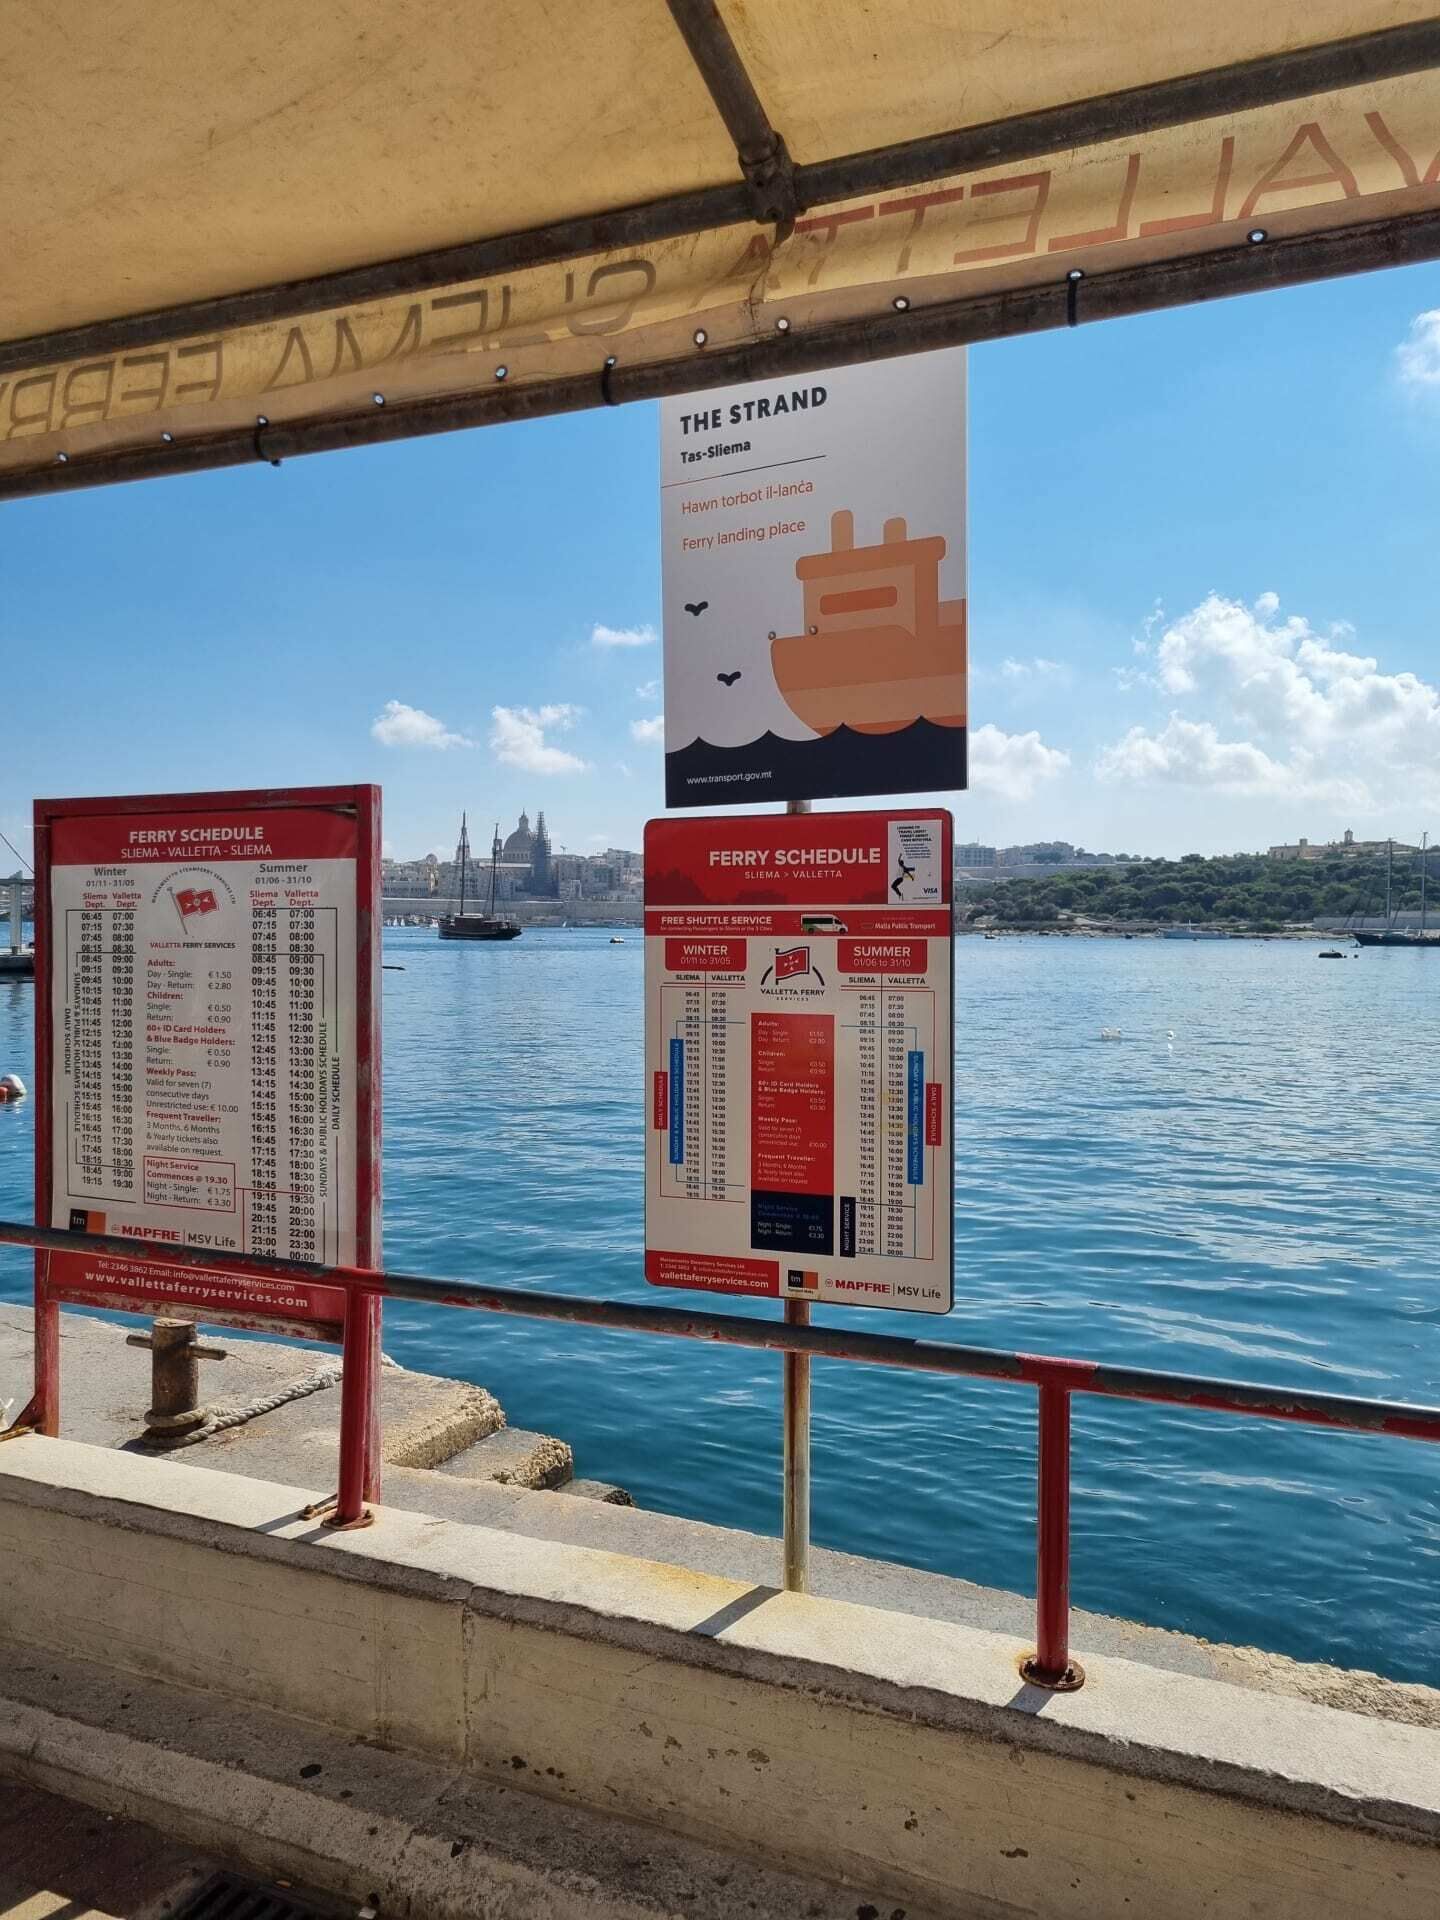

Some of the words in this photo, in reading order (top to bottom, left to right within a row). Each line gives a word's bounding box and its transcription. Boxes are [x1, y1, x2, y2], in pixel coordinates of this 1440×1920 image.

[680, 408, 722, 435] THE
[729, 386, 828, 425] STRAND
[680, 440, 752, 464] Tas-Sliema
[682, 498, 719, 515] Hawn
[722, 488, 763, 507] torbot
[683, 535, 714, 552] Ferry
[717, 525, 766, 545] landing
[769, 519, 806, 538] place
[687, 770, 772, 785] www.transport.gov.mt
[129, 829, 177, 844] FERRY
[180, 826, 264, 842] SCHEDULE
[121, 847, 160, 859] SLIEMA
[168, 845, 222, 857] VALLETTA
[231, 844, 273, 856] SLIEMA
[709, 850, 769, 867] FERRY
[775, 847, 881, 865] SCHEDULE
[94, 867, 127, 877] Winter
[259, 863, 309, 873] Summer
[744, 871, 780, 880] SLIEMA
[792, 869, 843, 879] VALLETTA
[86, 880, 107, 888] 01/11
[113, 879, 135, 887] 31/05
[255, 877, 280, 885] 01/06
[287, 876, 312, 884] 31/10
[82, 892, 108, 900] Sliema
[112, 891, 142, 900] Valletta
[249, 890, 279, 898] Sliema
[284, 889, 319, 898] Valletta
[85, 901, 106, 909] Dept.
[116, 900, 138, 908] Dept.
[252, 899, 276, 908] Dept.
[289, 898, 314, 907] Dept.
[252, 910, 276, 918] 06:45
[289, 910, 314, 918] 07:00
[252, 922, 276, 930] 07:15
[289, 921, 314, 930] 07:30
[661, 916, 685, 925] FREE
[686, 916, 729, 925] SHUTTLE
[731, 916, 772, 925] SERVICE
[252, 933, 276, 941] 07:45
[289, 933, 314, 941] 08:00
[683, 945, 728, 956] WINTER
[853, 946, 911, 957] SUMMER
[878, 959, 889, 967] to
[892, 958, 911, 968] 31/10
[147, 970, 162, 979] Day
[252, 967, 276, 975] 09:15
[289, 967, 314, 976] 09:30
[888, 977, 925, 985] VALLETTA
[147, 992, 184, 1000] Children:
[252, 1000, 276, 1009] 10:45
[289, 1001, 314, 1010] 11:00
[173, 1025, 192, 1033] Card
[194, 1026, 226, 1034] Holders
[173, 1036, 199, 1045] Badge
[252, 1034, 276, 1043] 12:15
[289, 1035, 314, 1044] 12:30
[319, 1021, 328, 1070] SCHEDULE
[146, 1067, 175, 1077] Weekly
[176, 1069, 197, 1077] Pass:
[252, 1068, 276, 1077] 13:45
[289, 1070, 314, 1078] 14:00
[146, 1078, 166, 1087] Valid
[331, 1056, 340, 1104] SCHEDULE
[146, 1091, 190, 1099] consecutive
[191, 1092, 209, 1101] days
[319, 1070, 328, 1116] HOLIDAYS
[146, 1100, 192, 1109] Unrestricted
[217, 1104, 239, 1113] 10.00
[252, 1102, 276, 1111] 15:15
[289, 1104, 314, 1113] 15:30
[146, 1110, 182, 1120] Frequent
[331, 1106, 340, 1130] DAILY
[190, 1124, 221, 1134] Months
[319, 1118, 328, 1147] PUBLIC
[153, 1132, 175, 1142] Yearly
[176, 1134, 202, 1143] tickets
[146, 1143, 179, 1153] available
[192, 1148, 223, 1157] request.
[252, 1147, 276, 1156] 17:15
[289, 1149, 314, 1159] 17:30
[146, 1160, 169, 1169] Night
[170, 1161, 199, 1171] Service
[146, 1170, 194, 1181] Commences
[204, 1175, 228, 1184] 19.30
[319, 1155, 328, 1198] SUNDAYS
[147, 1181, 167, 1190] Night
[147, 1191, 167, 1201] Night
[252, 1203, 276, 1212] 19:45
[289, 1206, 314, 1216] 20:00
[121, 1224, 181, 1242] MAPFRE
[188, 1232, 212, 1244] MSV
[214, 1234, 237, 1248] Life
[252, 1226, 276, 1235] 21:15
[289, 1229, 314, 1239] 22:00
[252, 1237, 276, 1246] 23:00
[289, 1240, 314, 1250] 23:30
[97, 1260, 110, 1269] Tel:
[149, 1267, 173, 1278] Email:
[173, 1269, 295, 1292] info@vallettaferryservices.com
[660, 1271, 769, 1289] vallettaferryservices.com
[85, 1272, 309, 1308] www.vallettaferryservices.com
[835, 1279, 891, 1294] MAPFRE
[897, 1285, 920, 1297] MSV
[922, 1287, 942, 1299] Life
